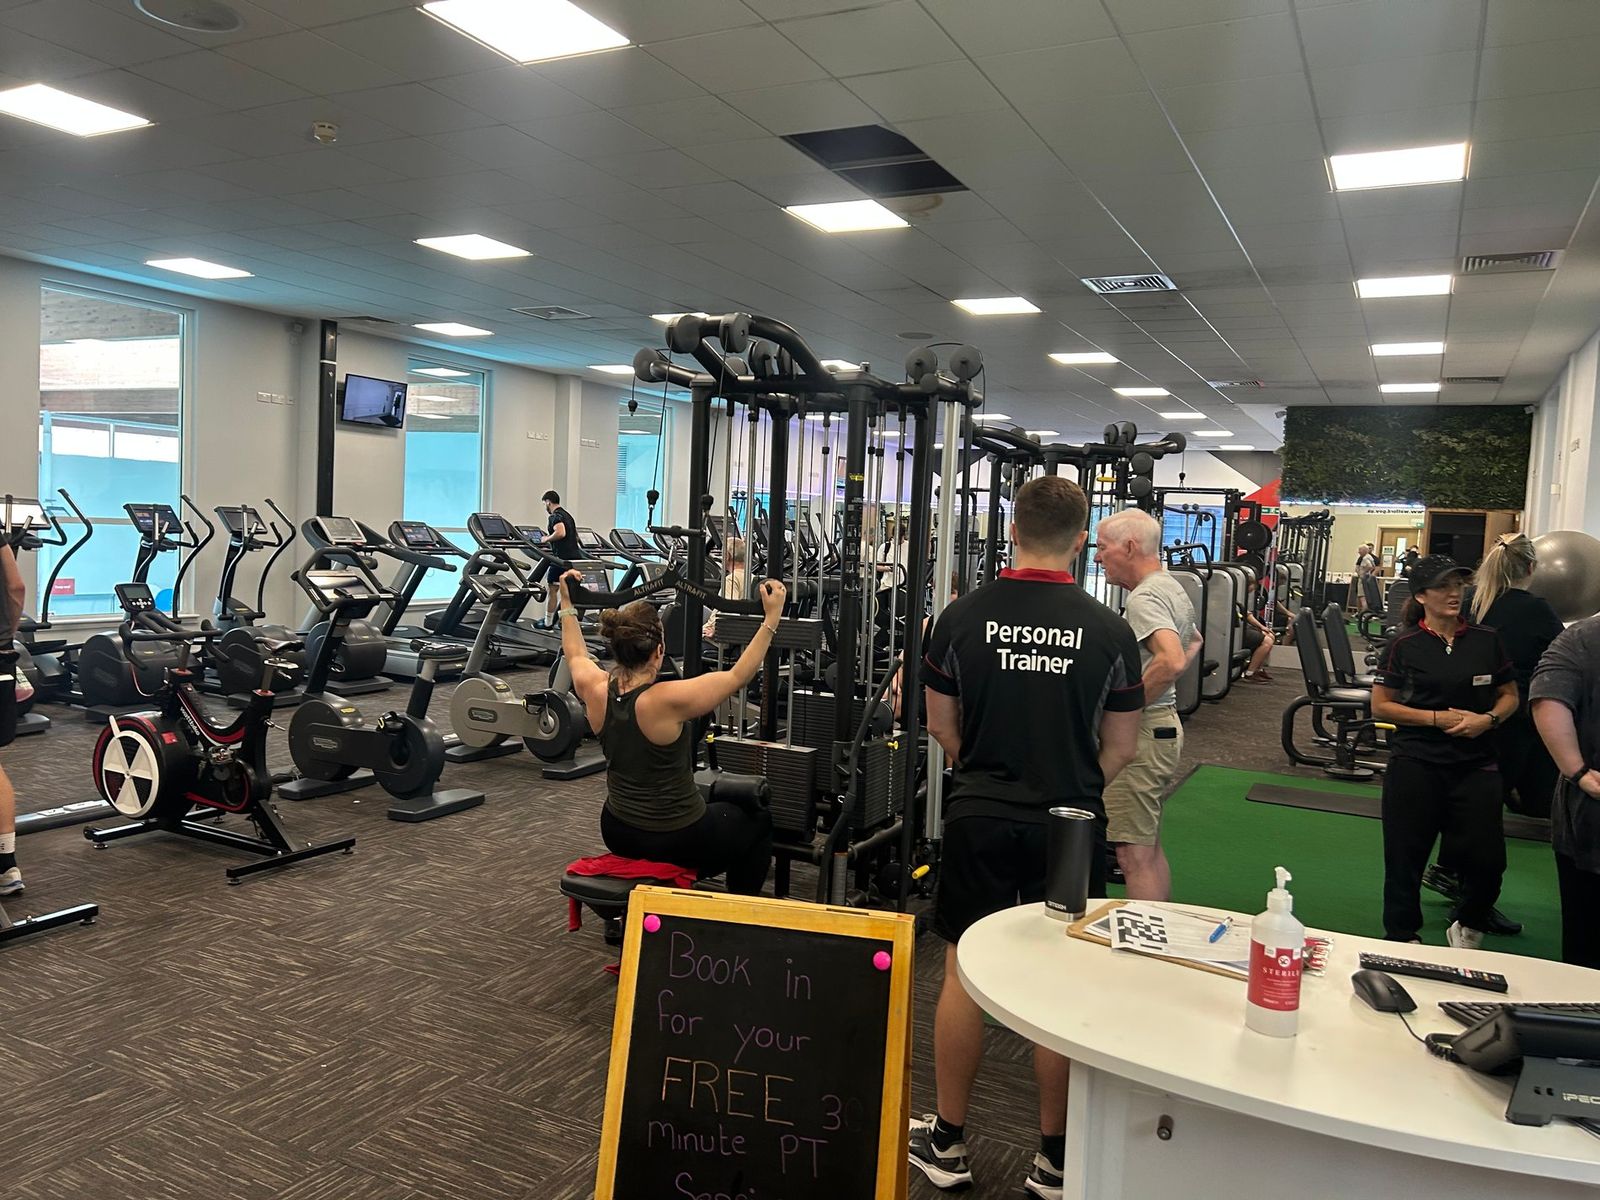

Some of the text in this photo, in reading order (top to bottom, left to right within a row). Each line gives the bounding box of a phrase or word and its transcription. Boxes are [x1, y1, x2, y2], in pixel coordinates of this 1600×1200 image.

[985, 620, 1083, 650] Personal
[996, 648, 1074, 675] Trainer
[786, 958, 811, 999] in
[657, 989, 811, 1064] for your
[661, 1056, 795, 1127] FREE
[779, 1134, 829, 1178] PT
